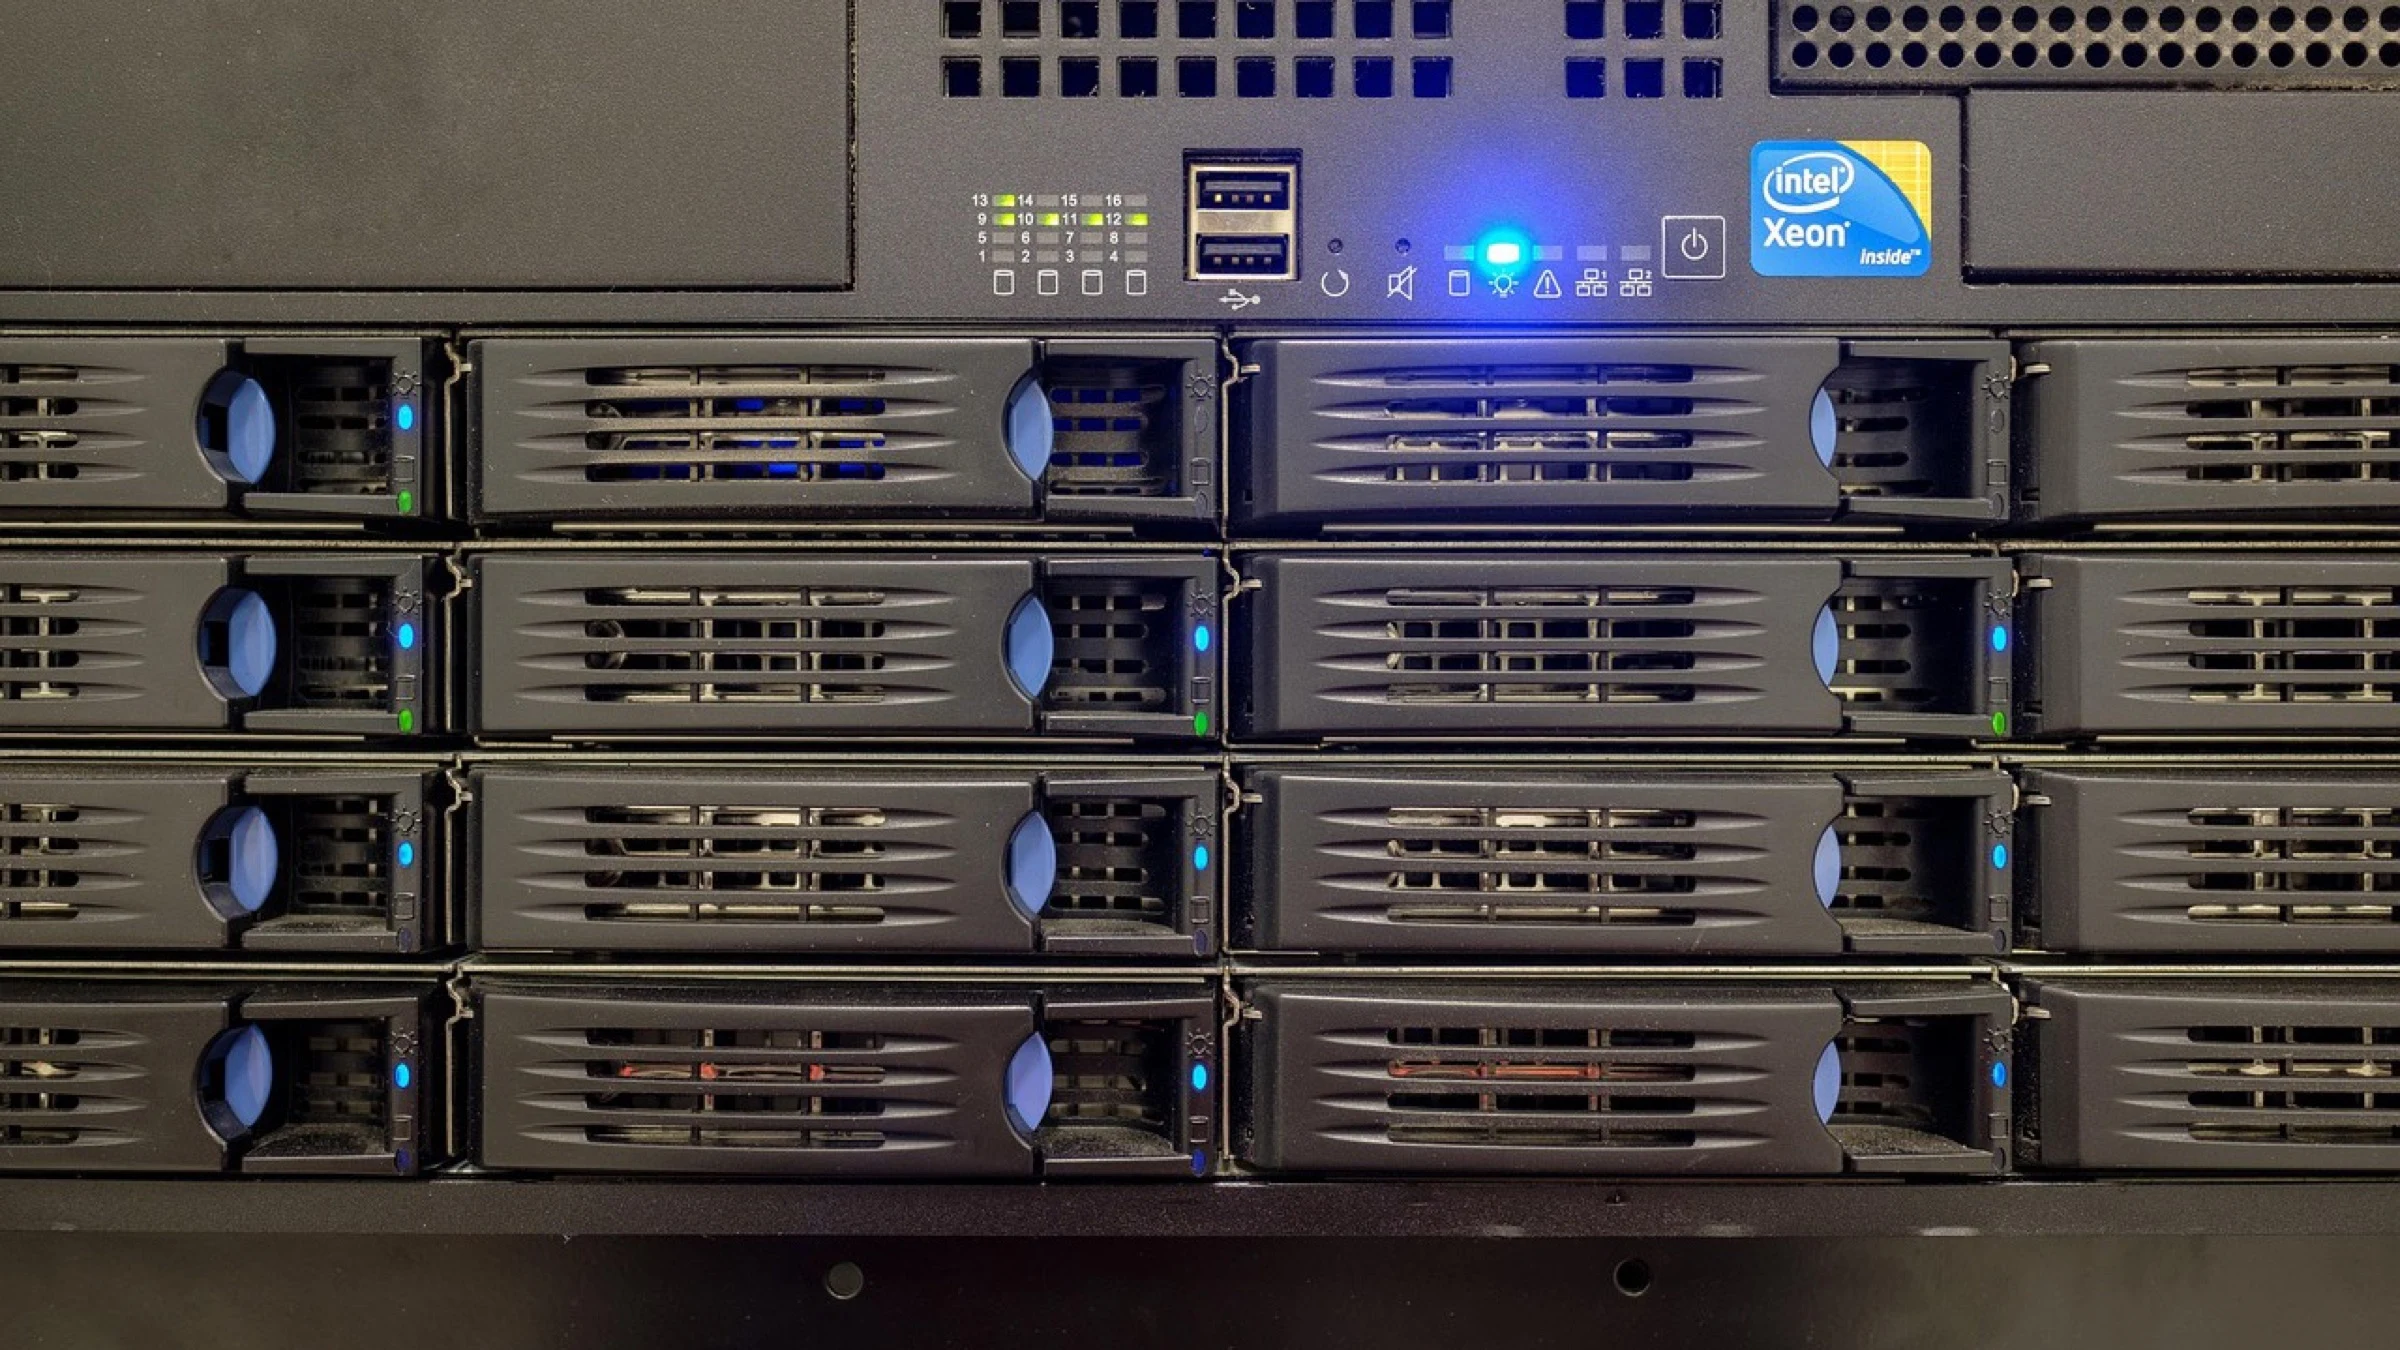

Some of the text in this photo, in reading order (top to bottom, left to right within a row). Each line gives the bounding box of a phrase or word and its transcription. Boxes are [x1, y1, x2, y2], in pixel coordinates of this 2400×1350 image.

[1775, 166, 1836, 194] intel
[972, 194, 1122, 207] 13 14 15 16
[977, 213, 1122, 225] 9 10 11 12
[978, 231, 1119, 244] 5 6 7 8
[1763, 217, 1846, 247] Xeon
[979, 250, 1119, 263] 1 2 3 4
